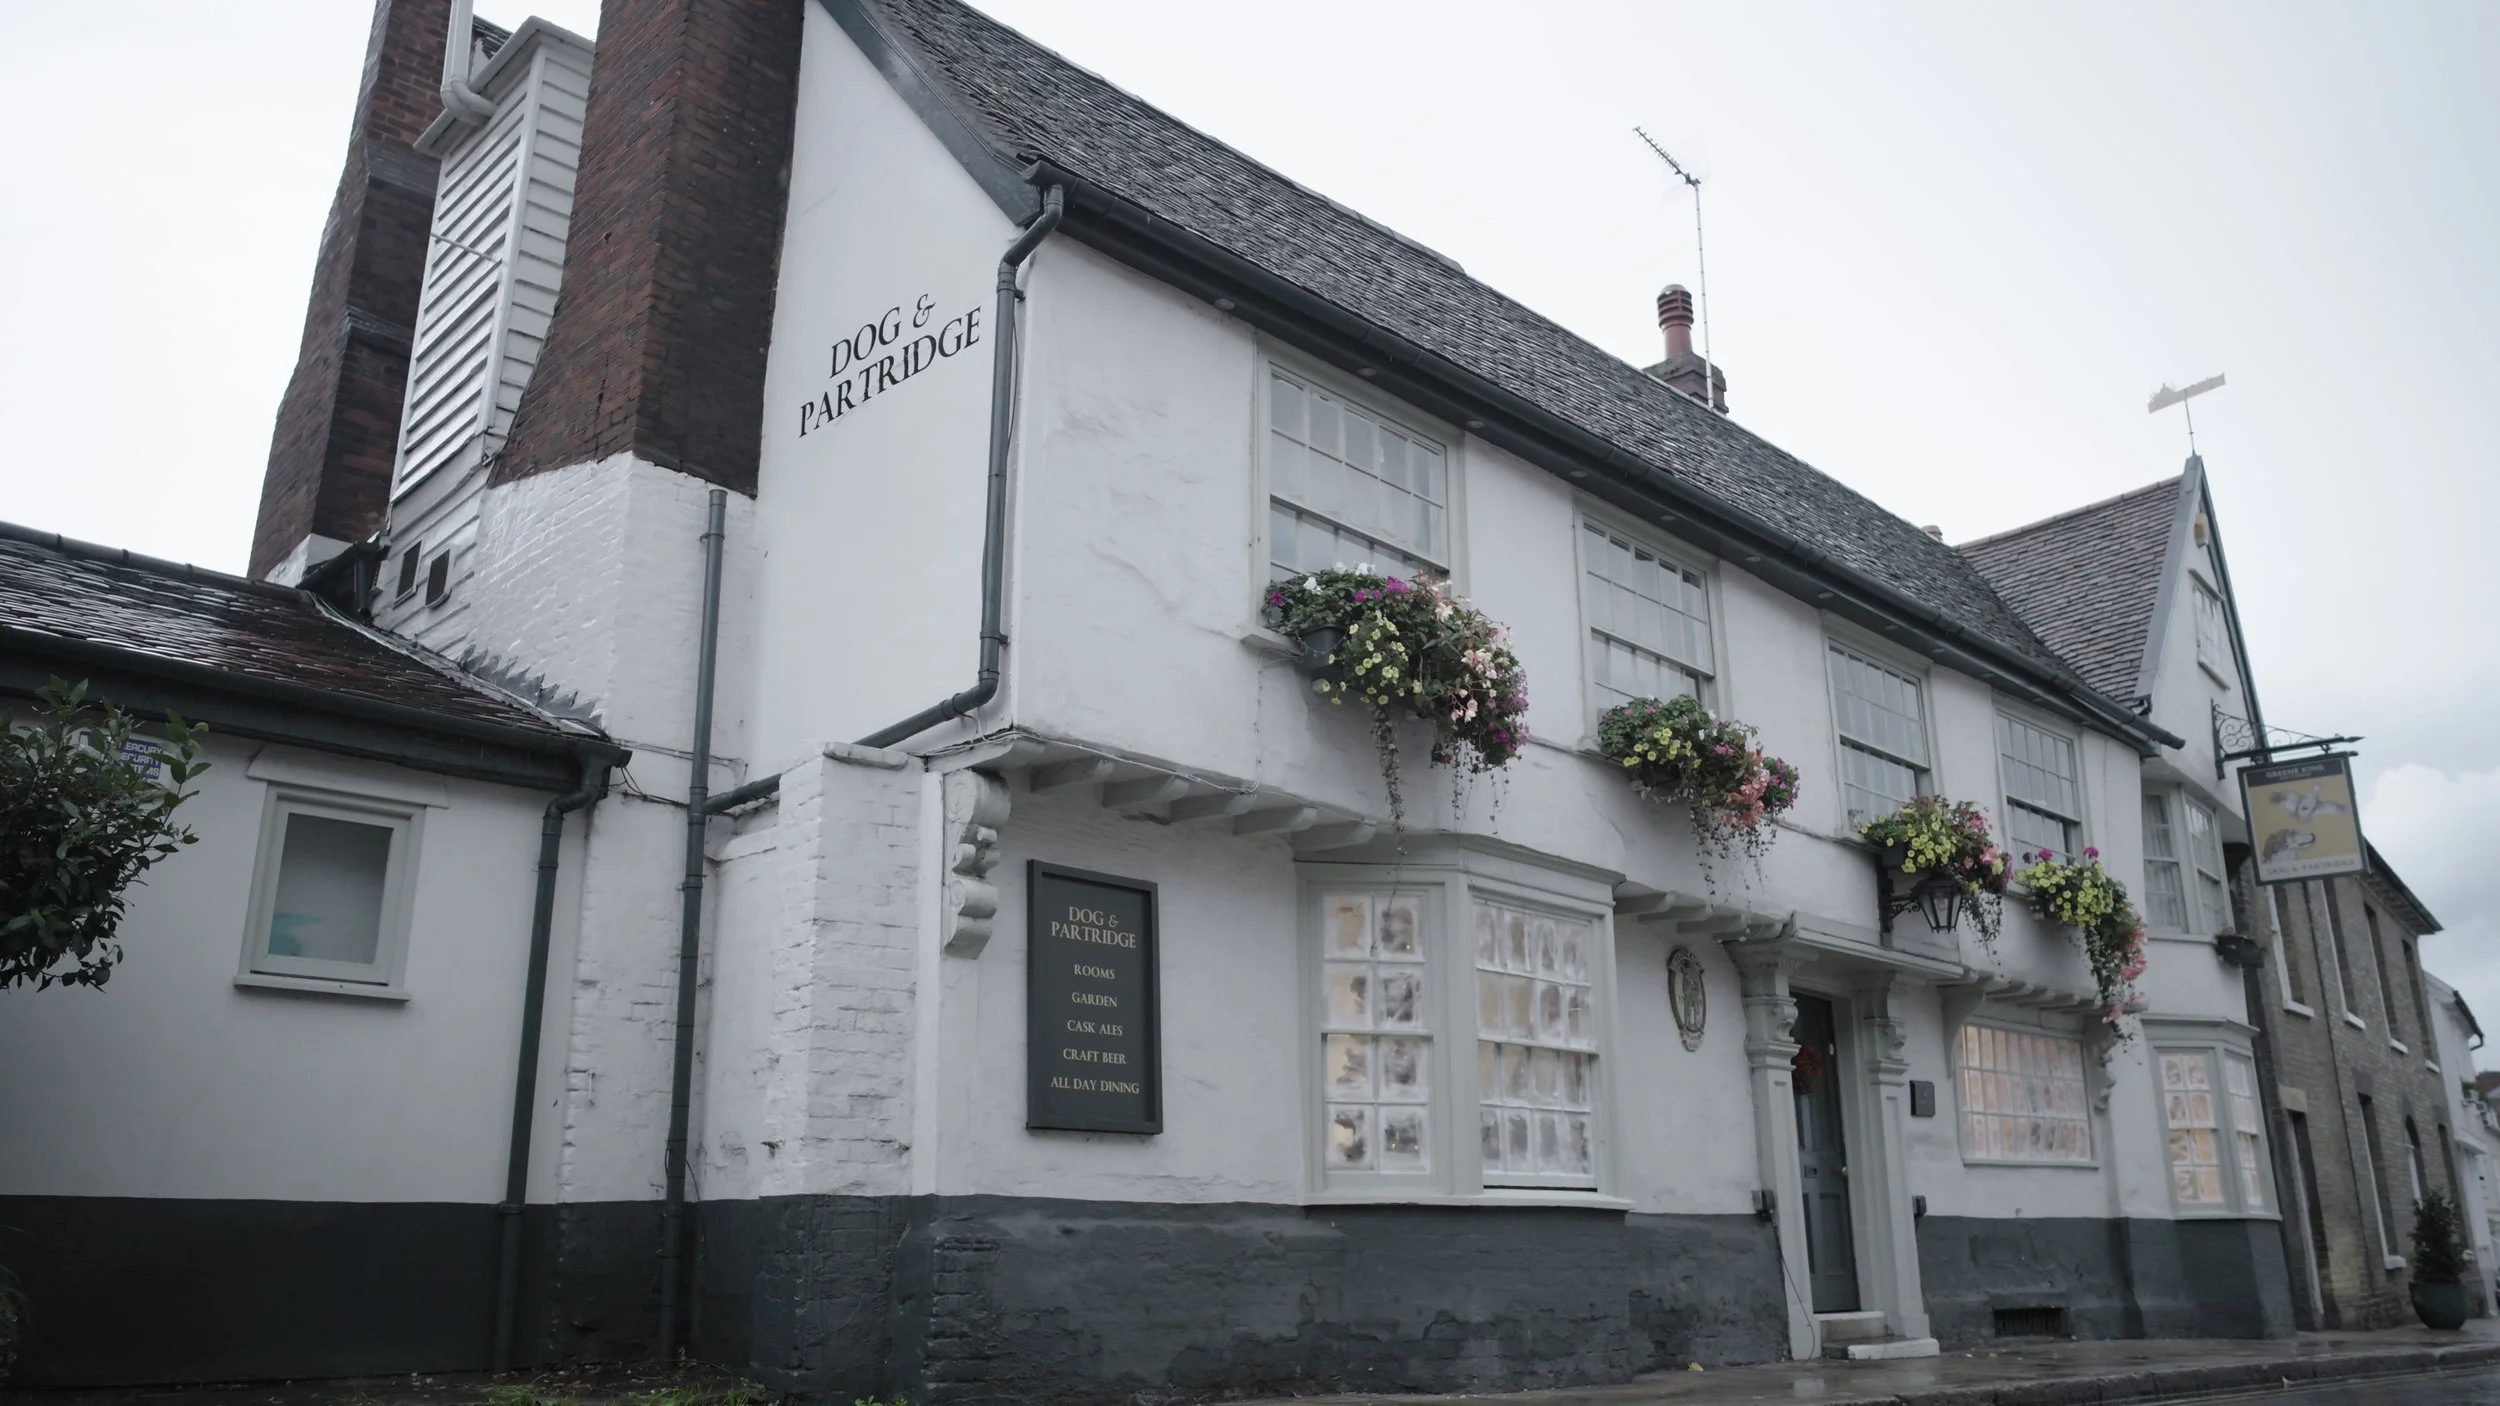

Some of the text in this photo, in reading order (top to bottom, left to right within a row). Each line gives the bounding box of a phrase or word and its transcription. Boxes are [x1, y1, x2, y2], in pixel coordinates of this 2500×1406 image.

[829, 294, 936, 379] DOG &
[799, 306, 981, 438] PARTRIDGE
[119, 741, 162, 755] ERCURY
[1068, 906, 1119, 928] DOG &
[1051, 921, 1136, 948] PARTRIDGE
[1074, 964, 1115, 980] ROOMS
[1072, 992, 1118, 1008] GARDEN
[1067, 1020, 1123, 1036] CASK ALES
[1063, 1048, 1126, 1065] CRAFT BEER
[1051, 1076, 1139, 1094] ALL DAY DINING
